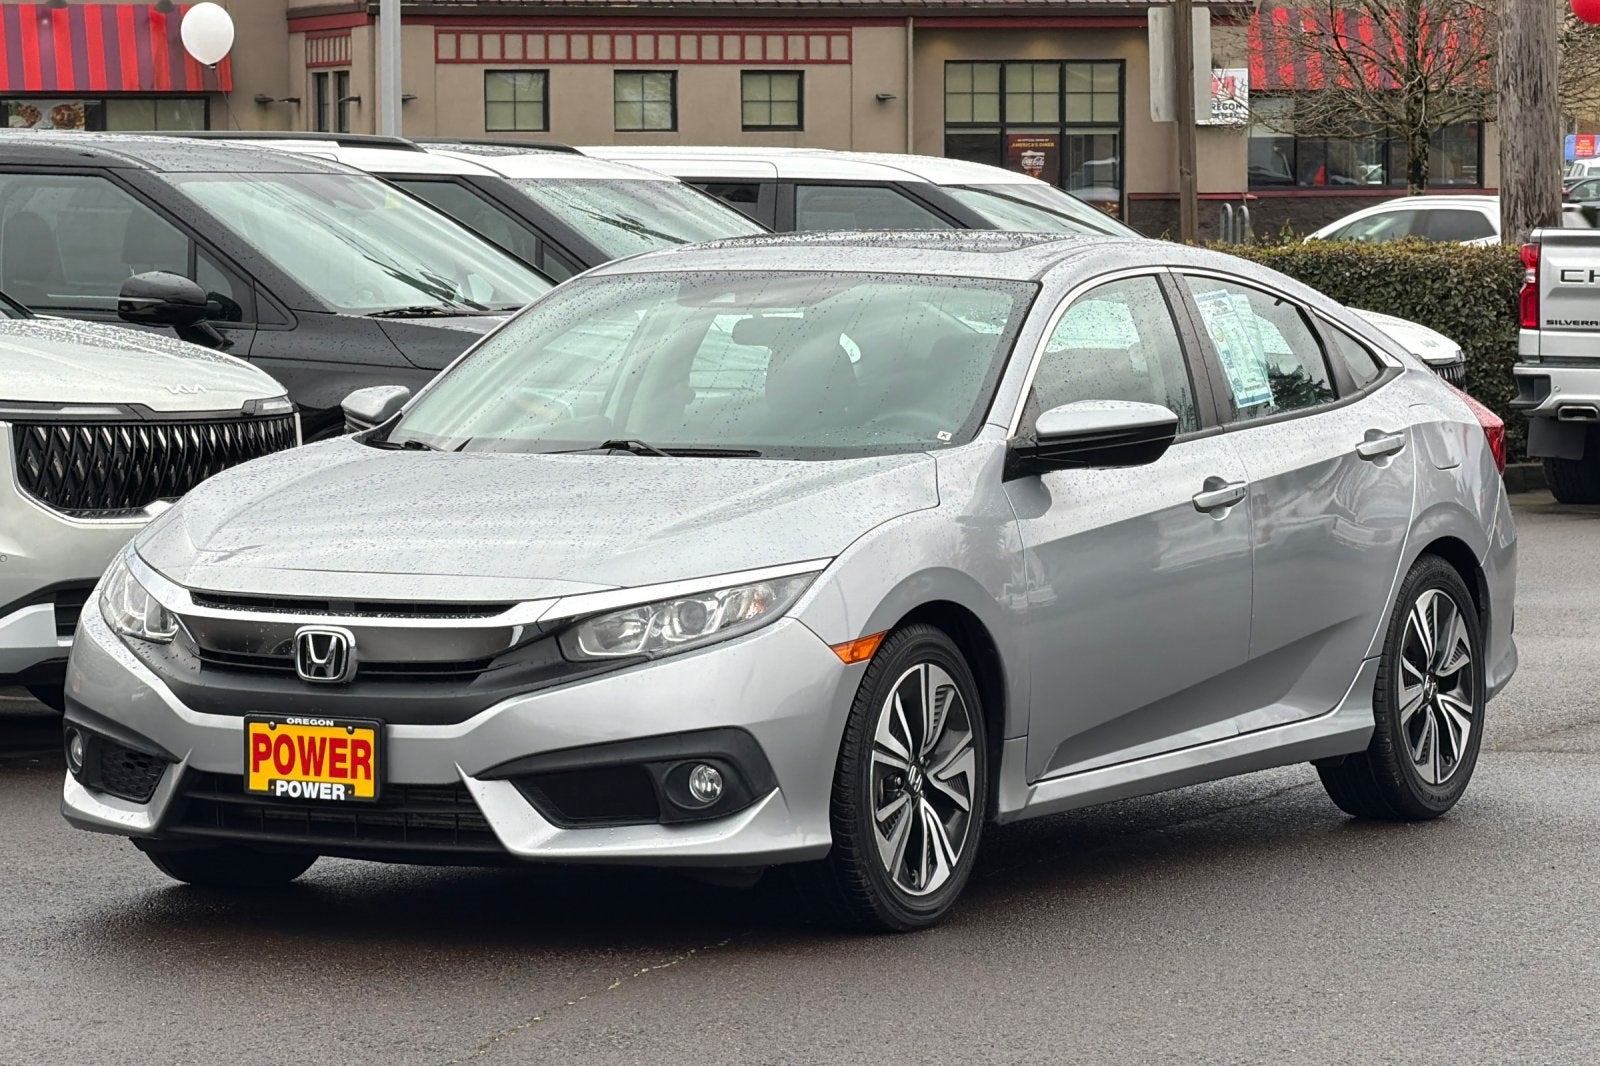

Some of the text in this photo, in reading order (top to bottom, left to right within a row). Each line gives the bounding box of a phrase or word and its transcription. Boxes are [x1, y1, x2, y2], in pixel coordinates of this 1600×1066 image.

[1211, 102, 1242, 111] REGON
[286, 717, 334, 727] OREGON
[252, 732, 372, 780] POWER
[275, 780, 346, 800] POWER
